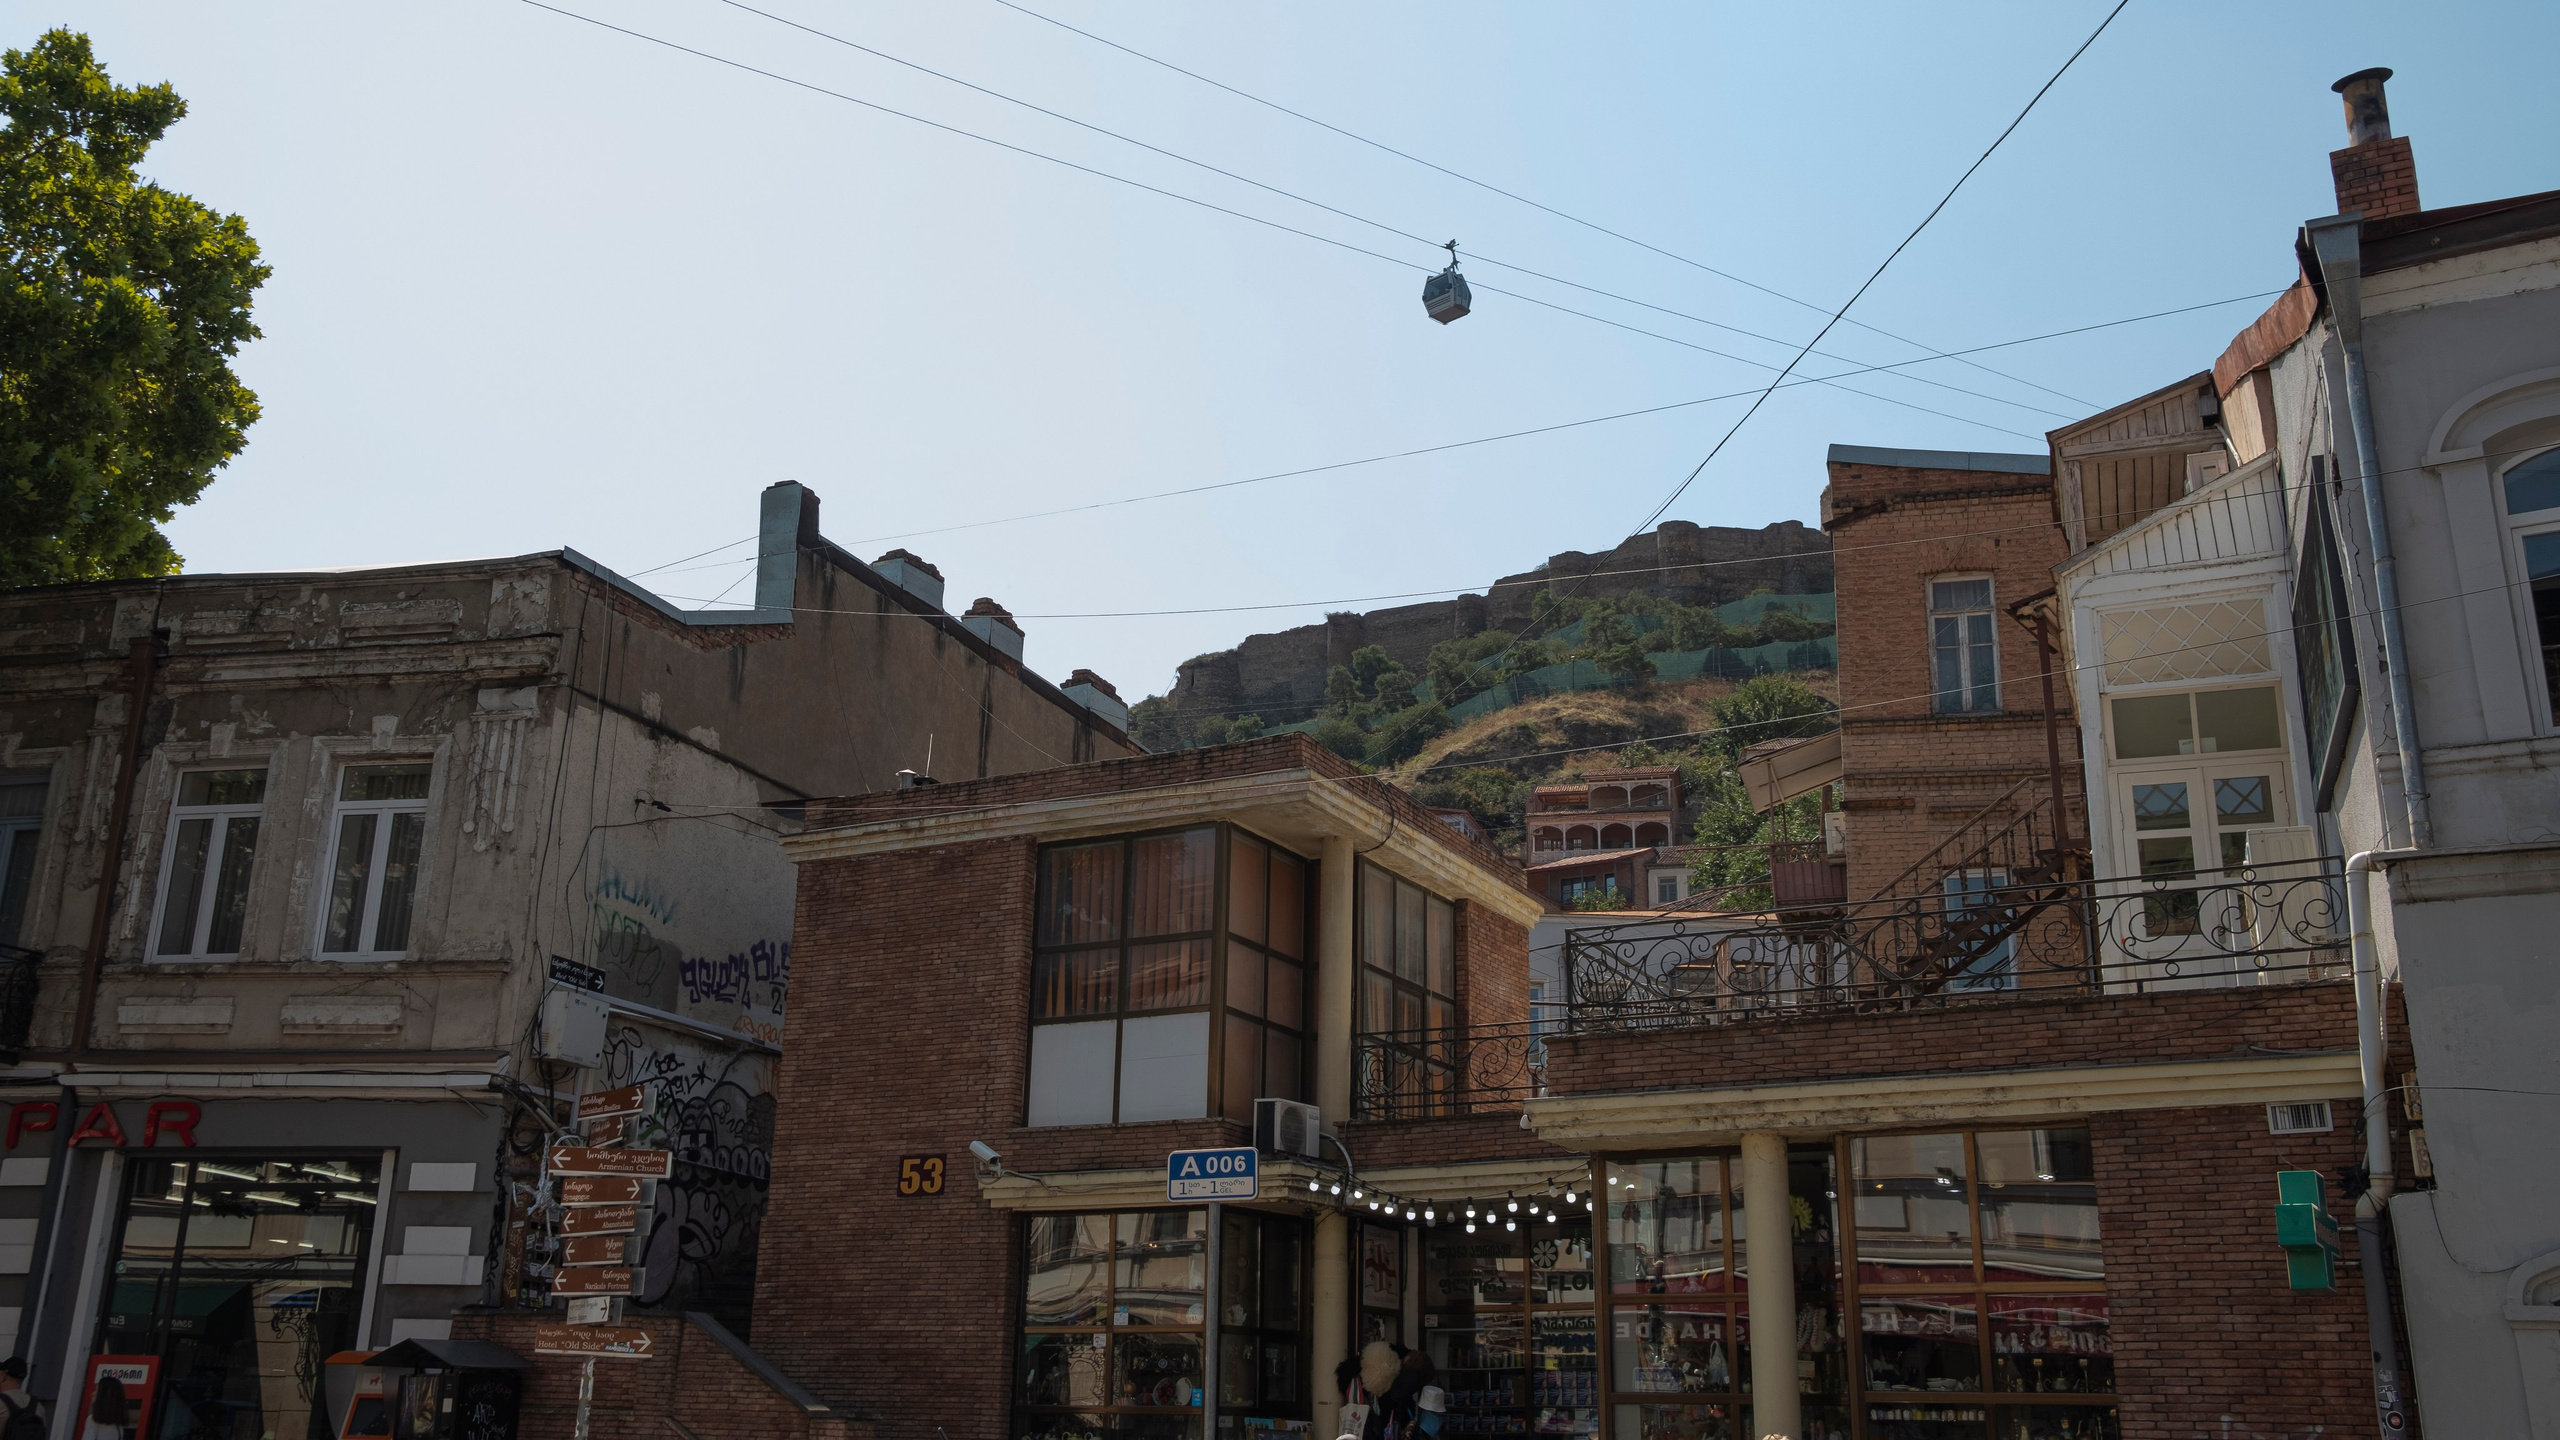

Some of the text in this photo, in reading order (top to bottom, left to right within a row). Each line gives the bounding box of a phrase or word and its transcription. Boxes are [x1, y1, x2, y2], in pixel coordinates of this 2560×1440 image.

[586, 1150, 665, 1164] სომხური ეკლესია
[597, 1163, 664, 1173] Armenian Church
[1179, 1155, 1246, 1177] A 006
[900, 1158, 944, 1195] 53
[564, 1181, 594, 1192] სინაგოგა
[1179, 1181, 1187, 1195] 1
[1210, 1180, 1218, 1194] 1
[1219, 1178, 1245, 1188] ლარი
[563, 1193, 590, 1202] Synagogue
[601, 1219, 634, 1229] Abanotubani
[606, 1251, 622, 1260] Mosque
[584, 1282, 630, 1290] Narikala Fortress
[538, 1340, 557, 1349] Hotel
